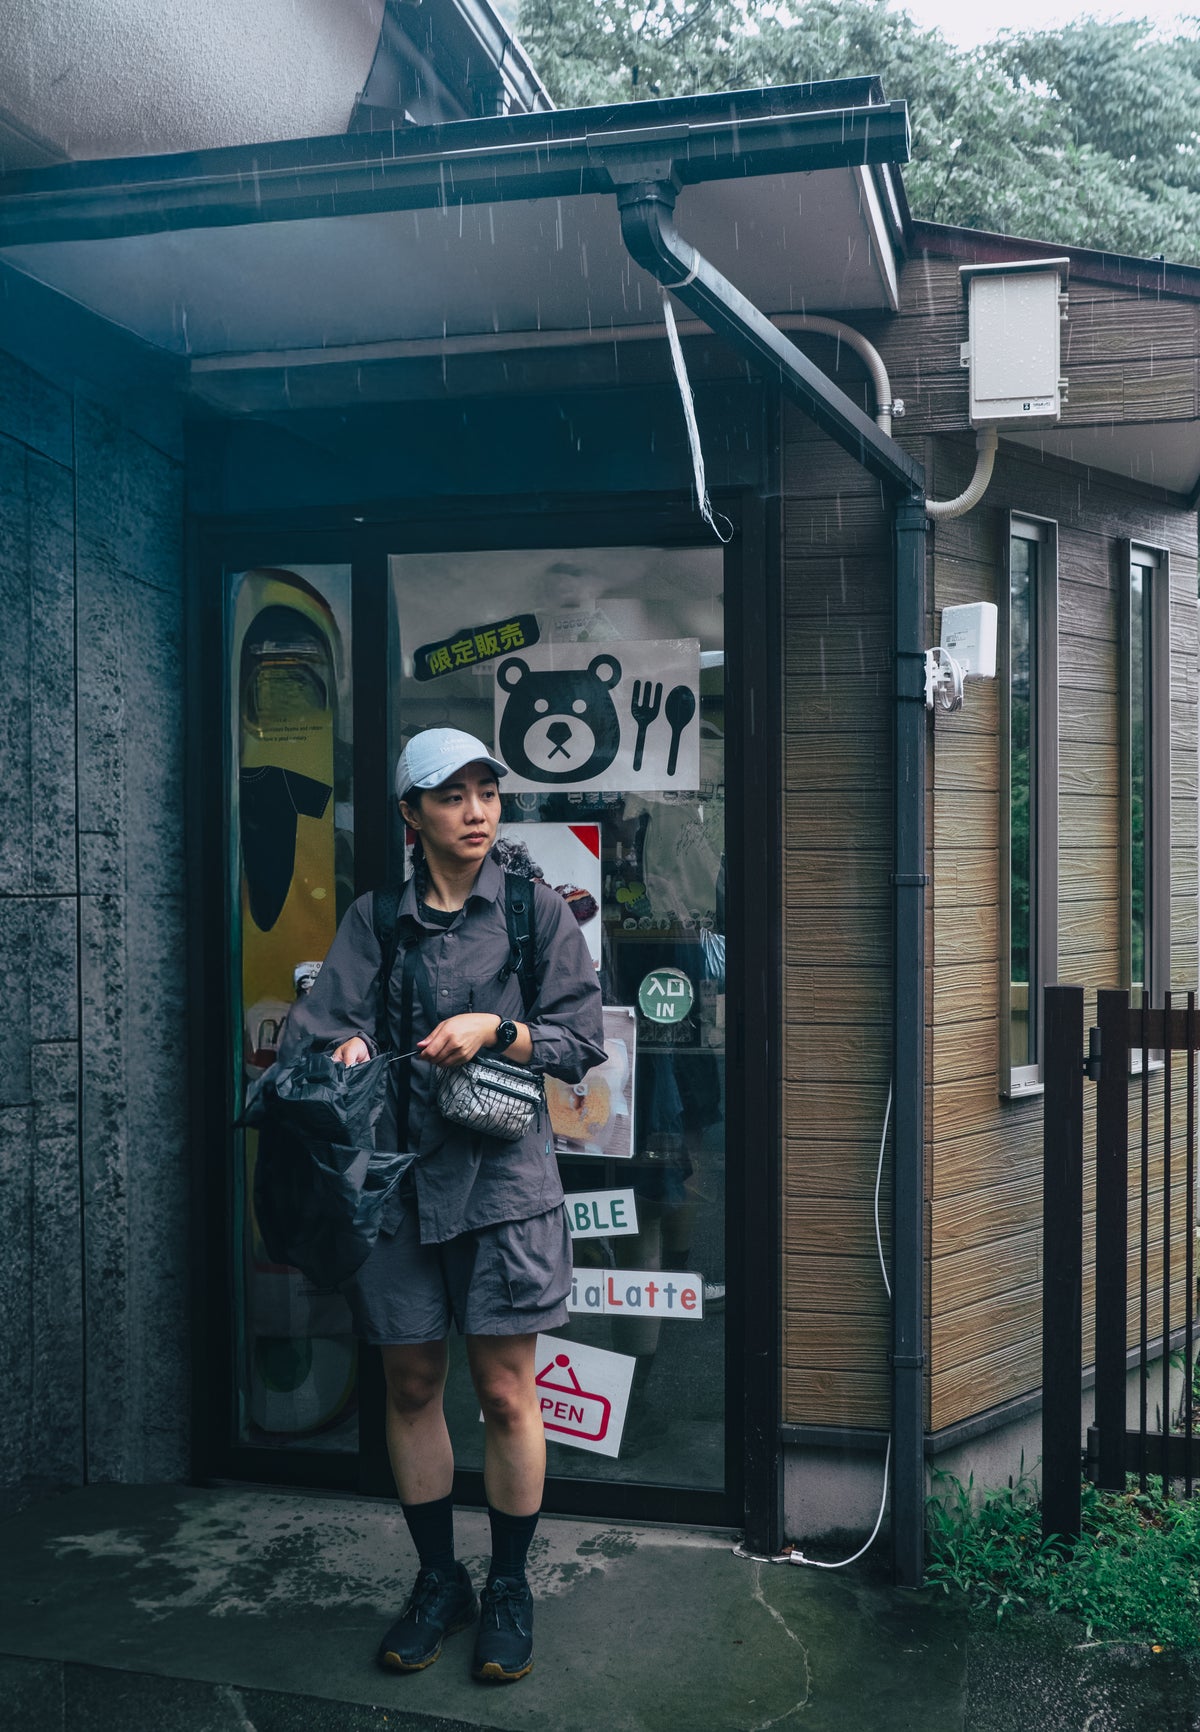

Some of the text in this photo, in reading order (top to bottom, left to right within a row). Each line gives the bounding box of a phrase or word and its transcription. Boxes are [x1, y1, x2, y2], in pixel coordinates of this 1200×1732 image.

[429, 622, 525, 675] 限定販売
[646, 977, 685, 997] 入口
[656, 1003, 676, 1018] IN
[571, 1276, 697, 1311] iaLatte
[540, 1396, 585, 1424] PEN
